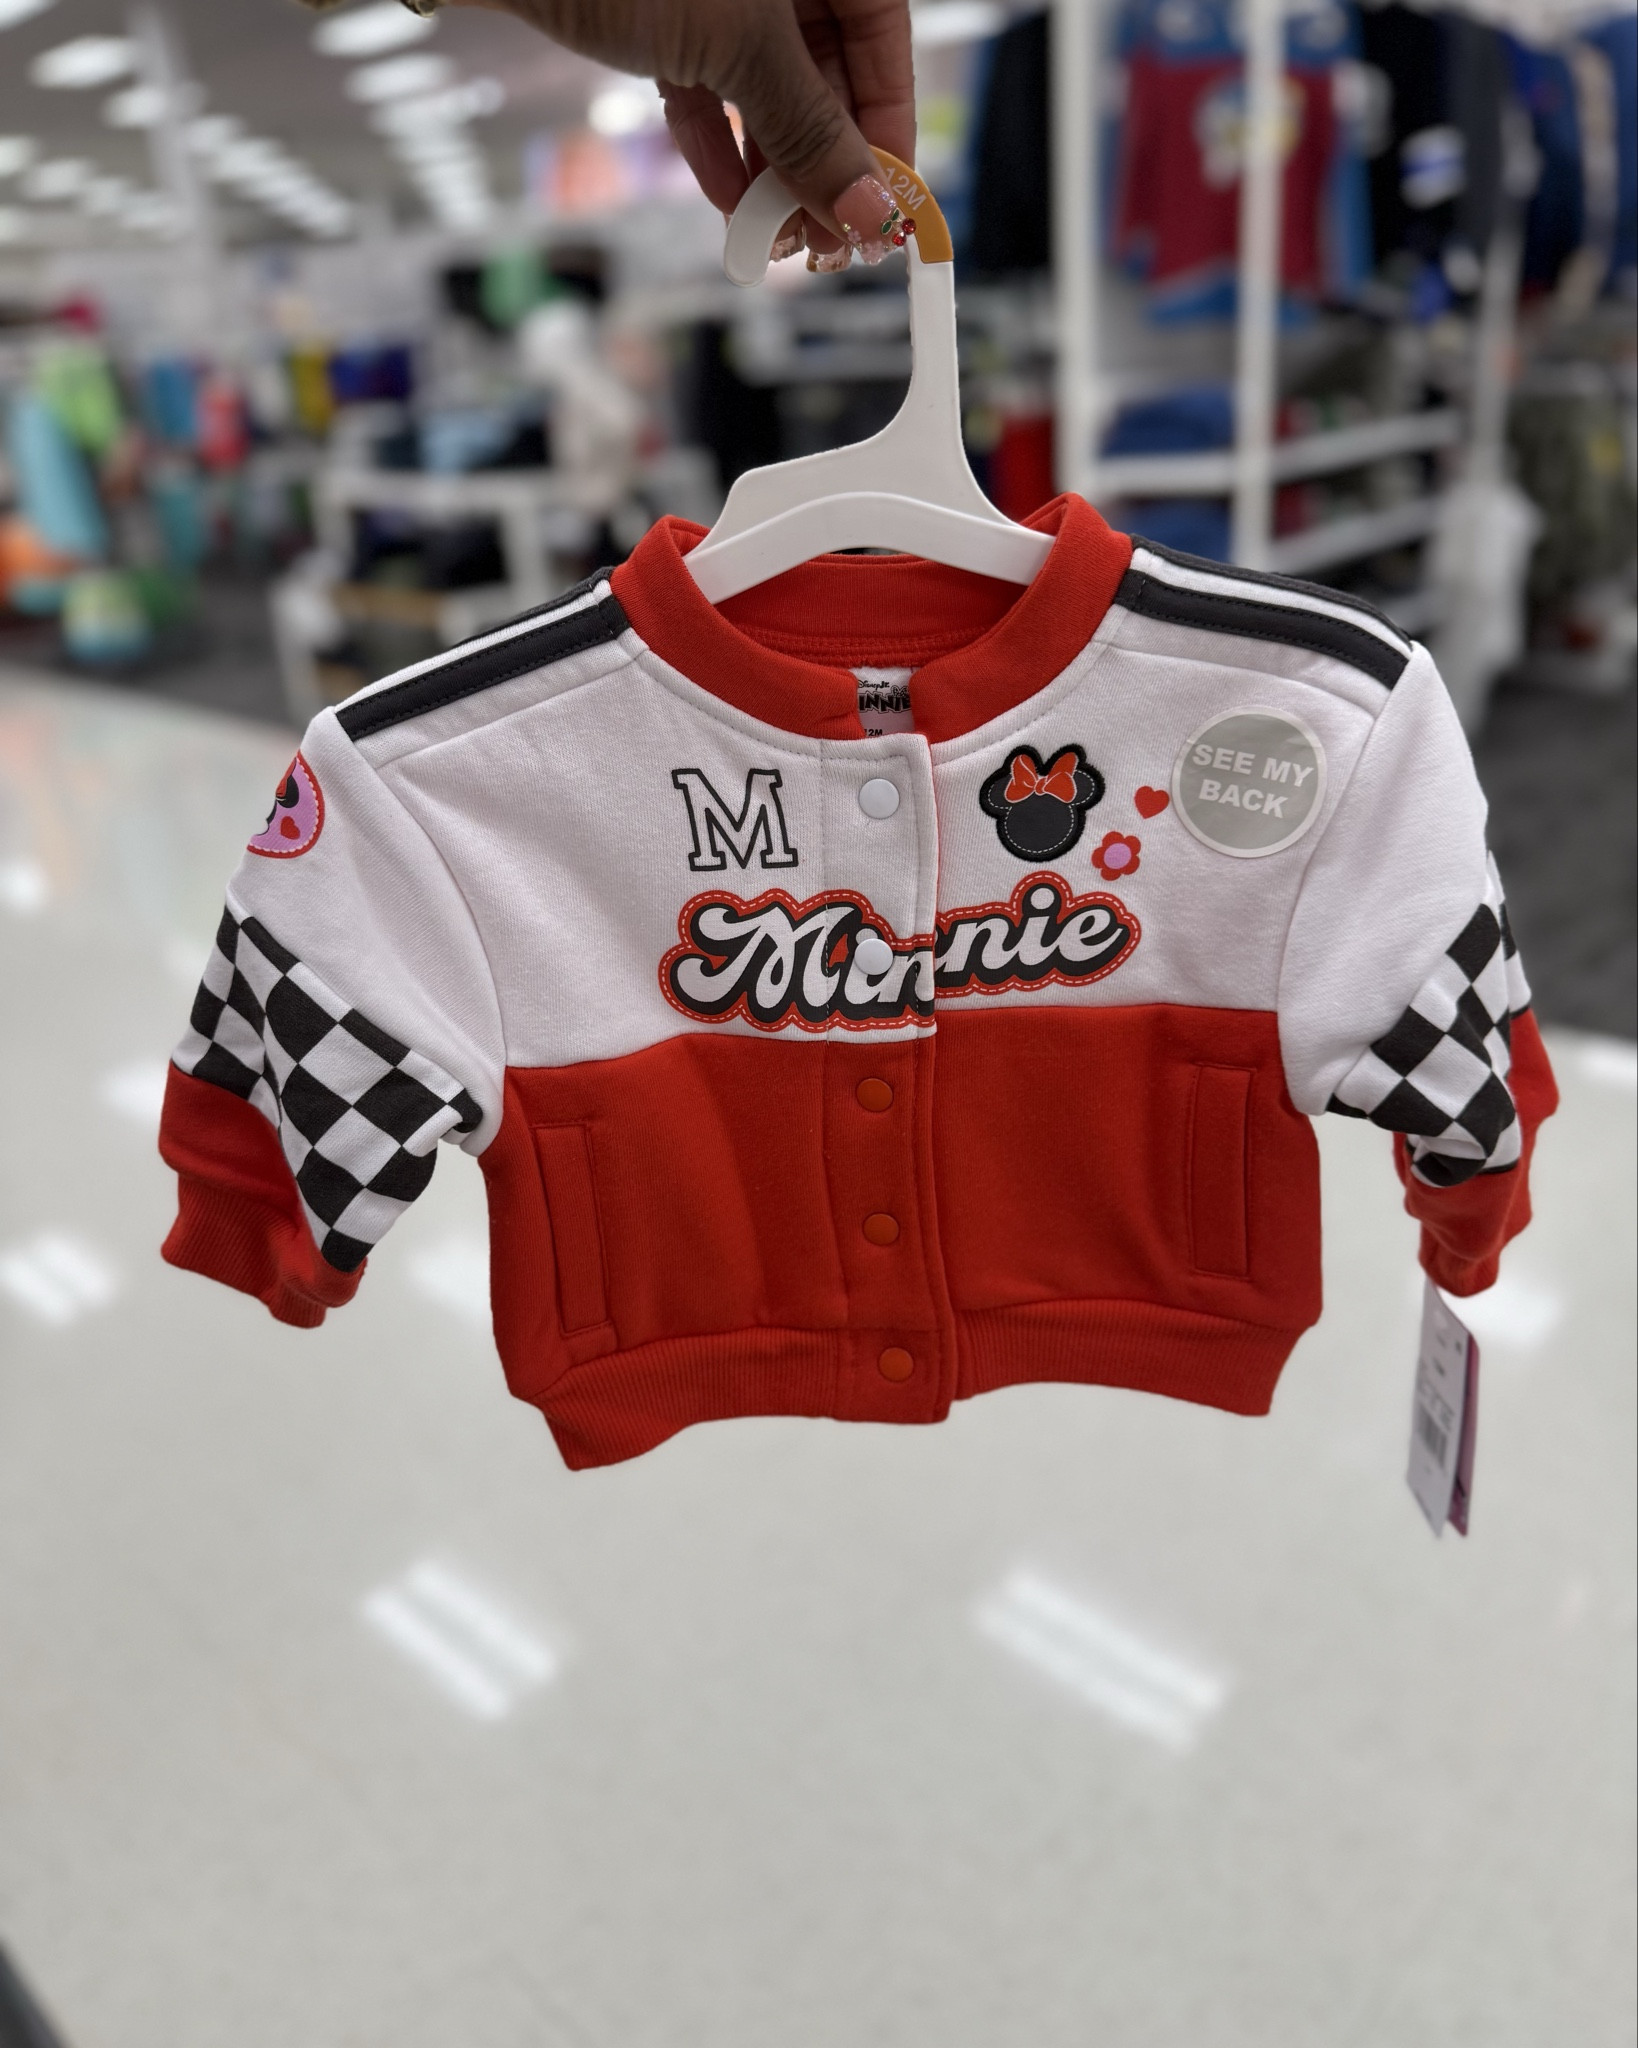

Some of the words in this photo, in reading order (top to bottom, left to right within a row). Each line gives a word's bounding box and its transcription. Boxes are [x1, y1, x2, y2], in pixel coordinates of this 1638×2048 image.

[886, 167, 927, 211] 12M
[858, 692, 911, 712] INNIE
[1192, 744, 1256, 775] SEE
[1262, 757, 1315, 788] MY
[671, 768, 798, 872] M
[1198, 779, 1289, 819] BACK
[669, 882, 1129, 1021] Minnie
